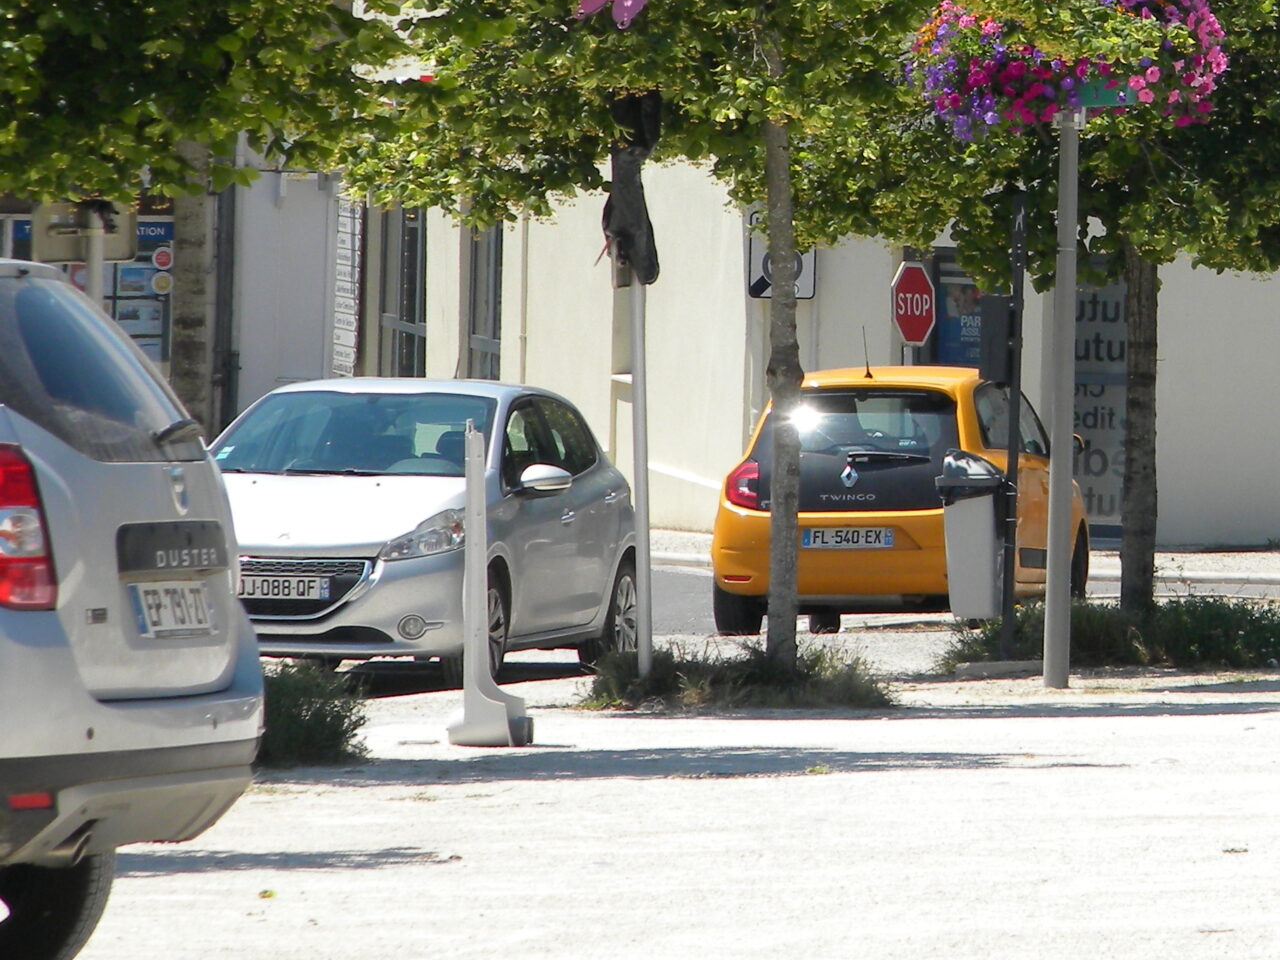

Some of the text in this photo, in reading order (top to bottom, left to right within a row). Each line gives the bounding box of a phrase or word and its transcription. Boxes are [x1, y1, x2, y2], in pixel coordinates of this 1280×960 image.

[897, 293, 931, 316] STOP
[820, 493, 876, 501] TWINGO
[156, 548, 218, 568] DUSTER
